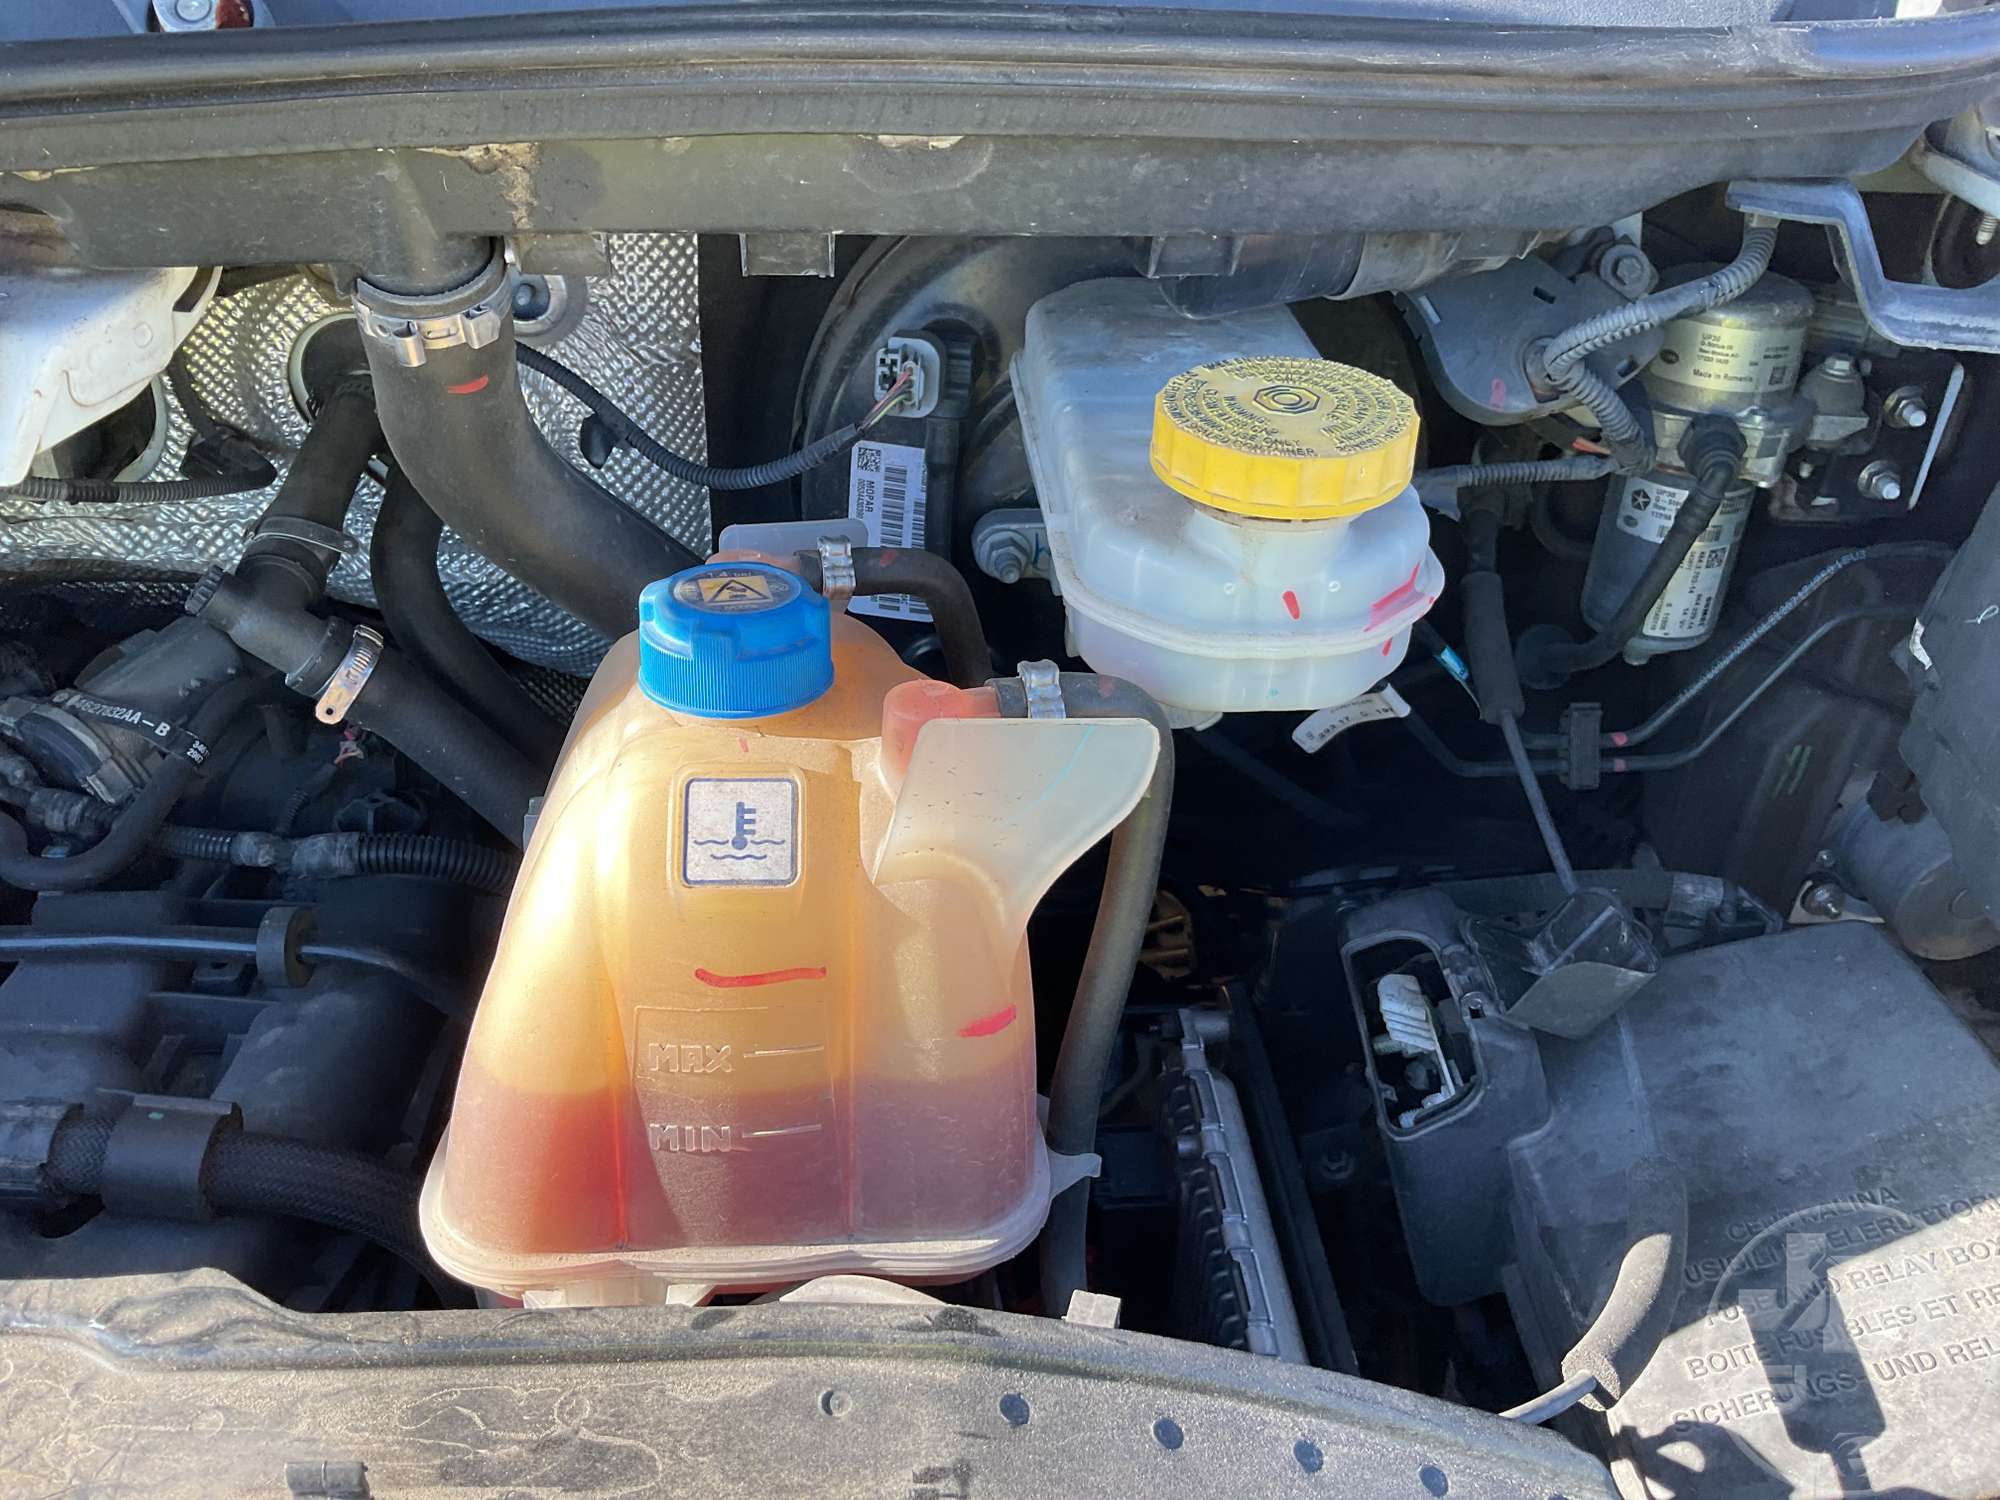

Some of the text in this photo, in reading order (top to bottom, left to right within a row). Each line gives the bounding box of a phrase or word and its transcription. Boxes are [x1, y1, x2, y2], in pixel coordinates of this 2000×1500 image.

[1231, 430, 1258, 441] USE
[1262, 437, 1300, 448] ONLY
[1250, 424, 1280, 436] CAP
[865, 479, 875, 514] MOPAR
[648, 1043, 733, 1072] MAX
[648, 1123, 731, 1152] MIN
[1684, 1239, 1787, 1285] USIBILI
[1845, 1252, 1938, 1290] RELAY
[1686, 1342, 1771, 1380] BOITE
[1776, 1304, 1918, 1354] FUSIBLES
[1920, 1294, 1959, 1321] ET
[1873, 1351, 1937, 1382] UND
